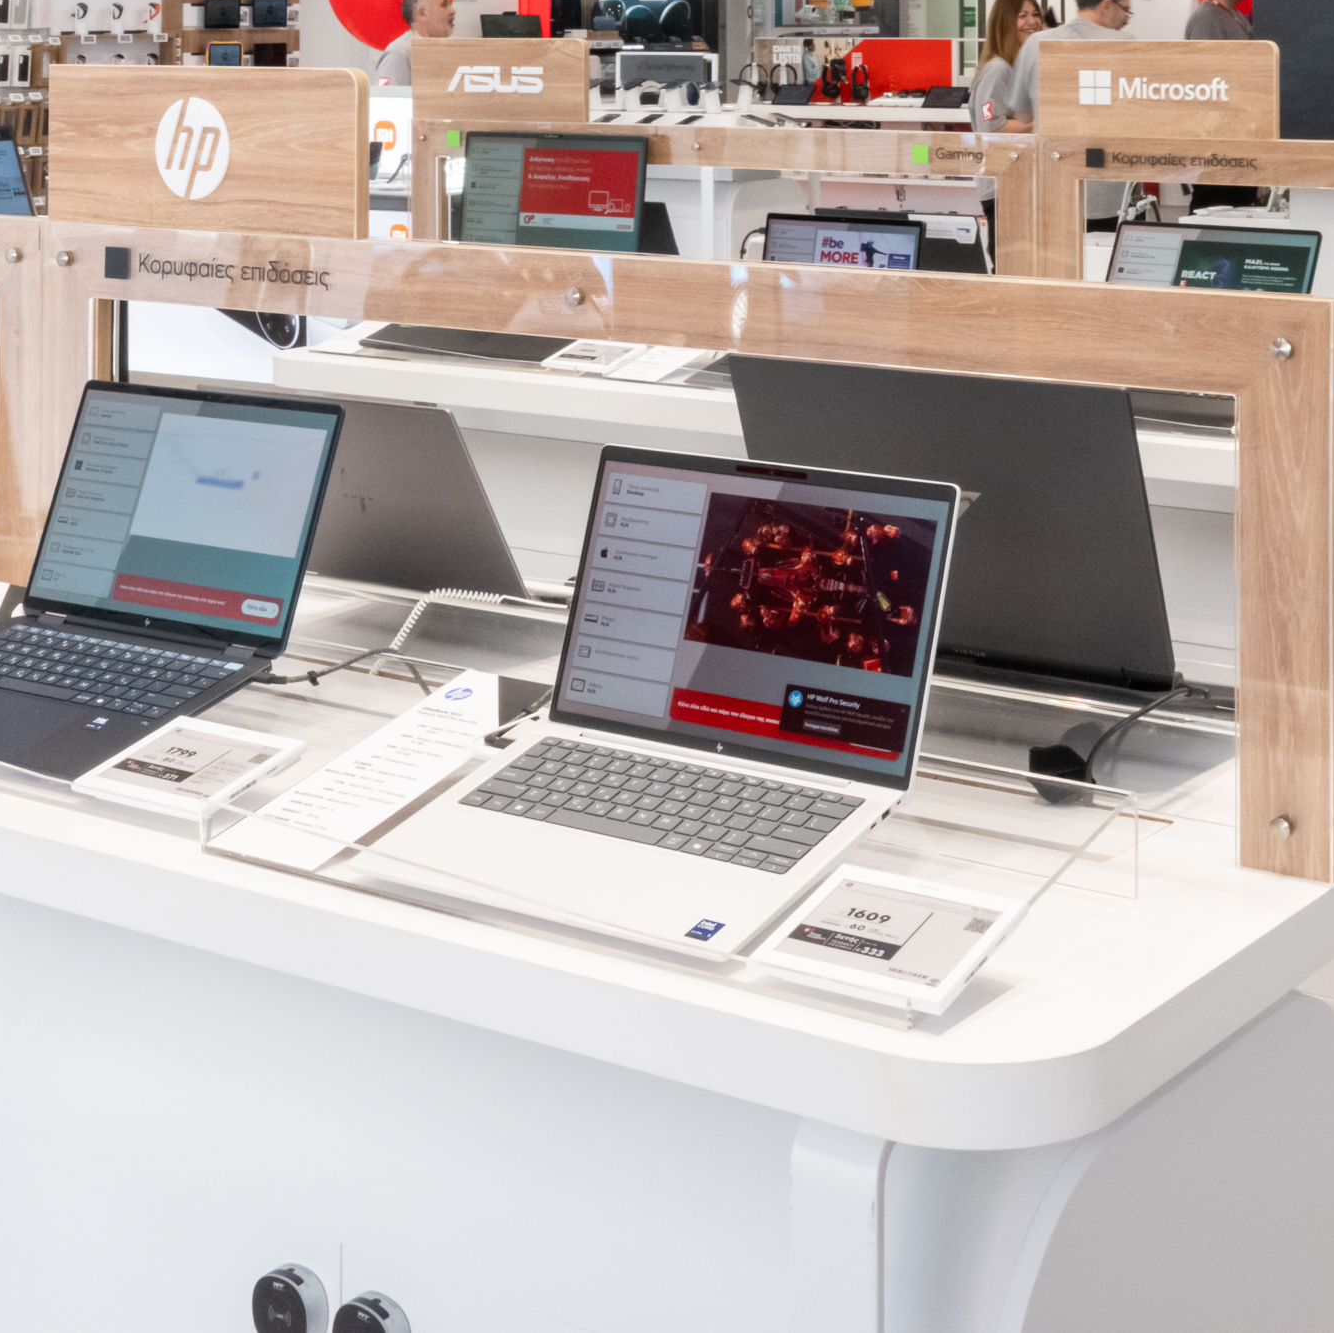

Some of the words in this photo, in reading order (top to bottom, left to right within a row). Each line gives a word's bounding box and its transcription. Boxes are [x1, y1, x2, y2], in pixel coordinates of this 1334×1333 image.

[446, 66, 544, 94] ASUS
[1119, 77, 1229, 102] Microsoft
[156, 97, 230, 200] hp
[935, 147, 984, 163] Gaming
[1112, 151, 1186, 168] Κορυφαίες
[1190, 153, 1257, 170] επιδόσεις
[821, 236, 845, 249] #be
[820, 250, 859, 265] MORE
[138, 250, 235, 284] Κορυφαίες
[239, 255, 330, 291] επιδόσεις
[1181, 269, 1217, 280] REACT
[807, 693, 816, 701] HP
[816, 694, 829, 703] Wolf
[829, 697, 839, 705] Pro
[839, 699, 861, 710] Security
[166, 746, 198, 758] 1799
[846, 906, 892, 925] 1609
[849, 923, 866, 931] 60
